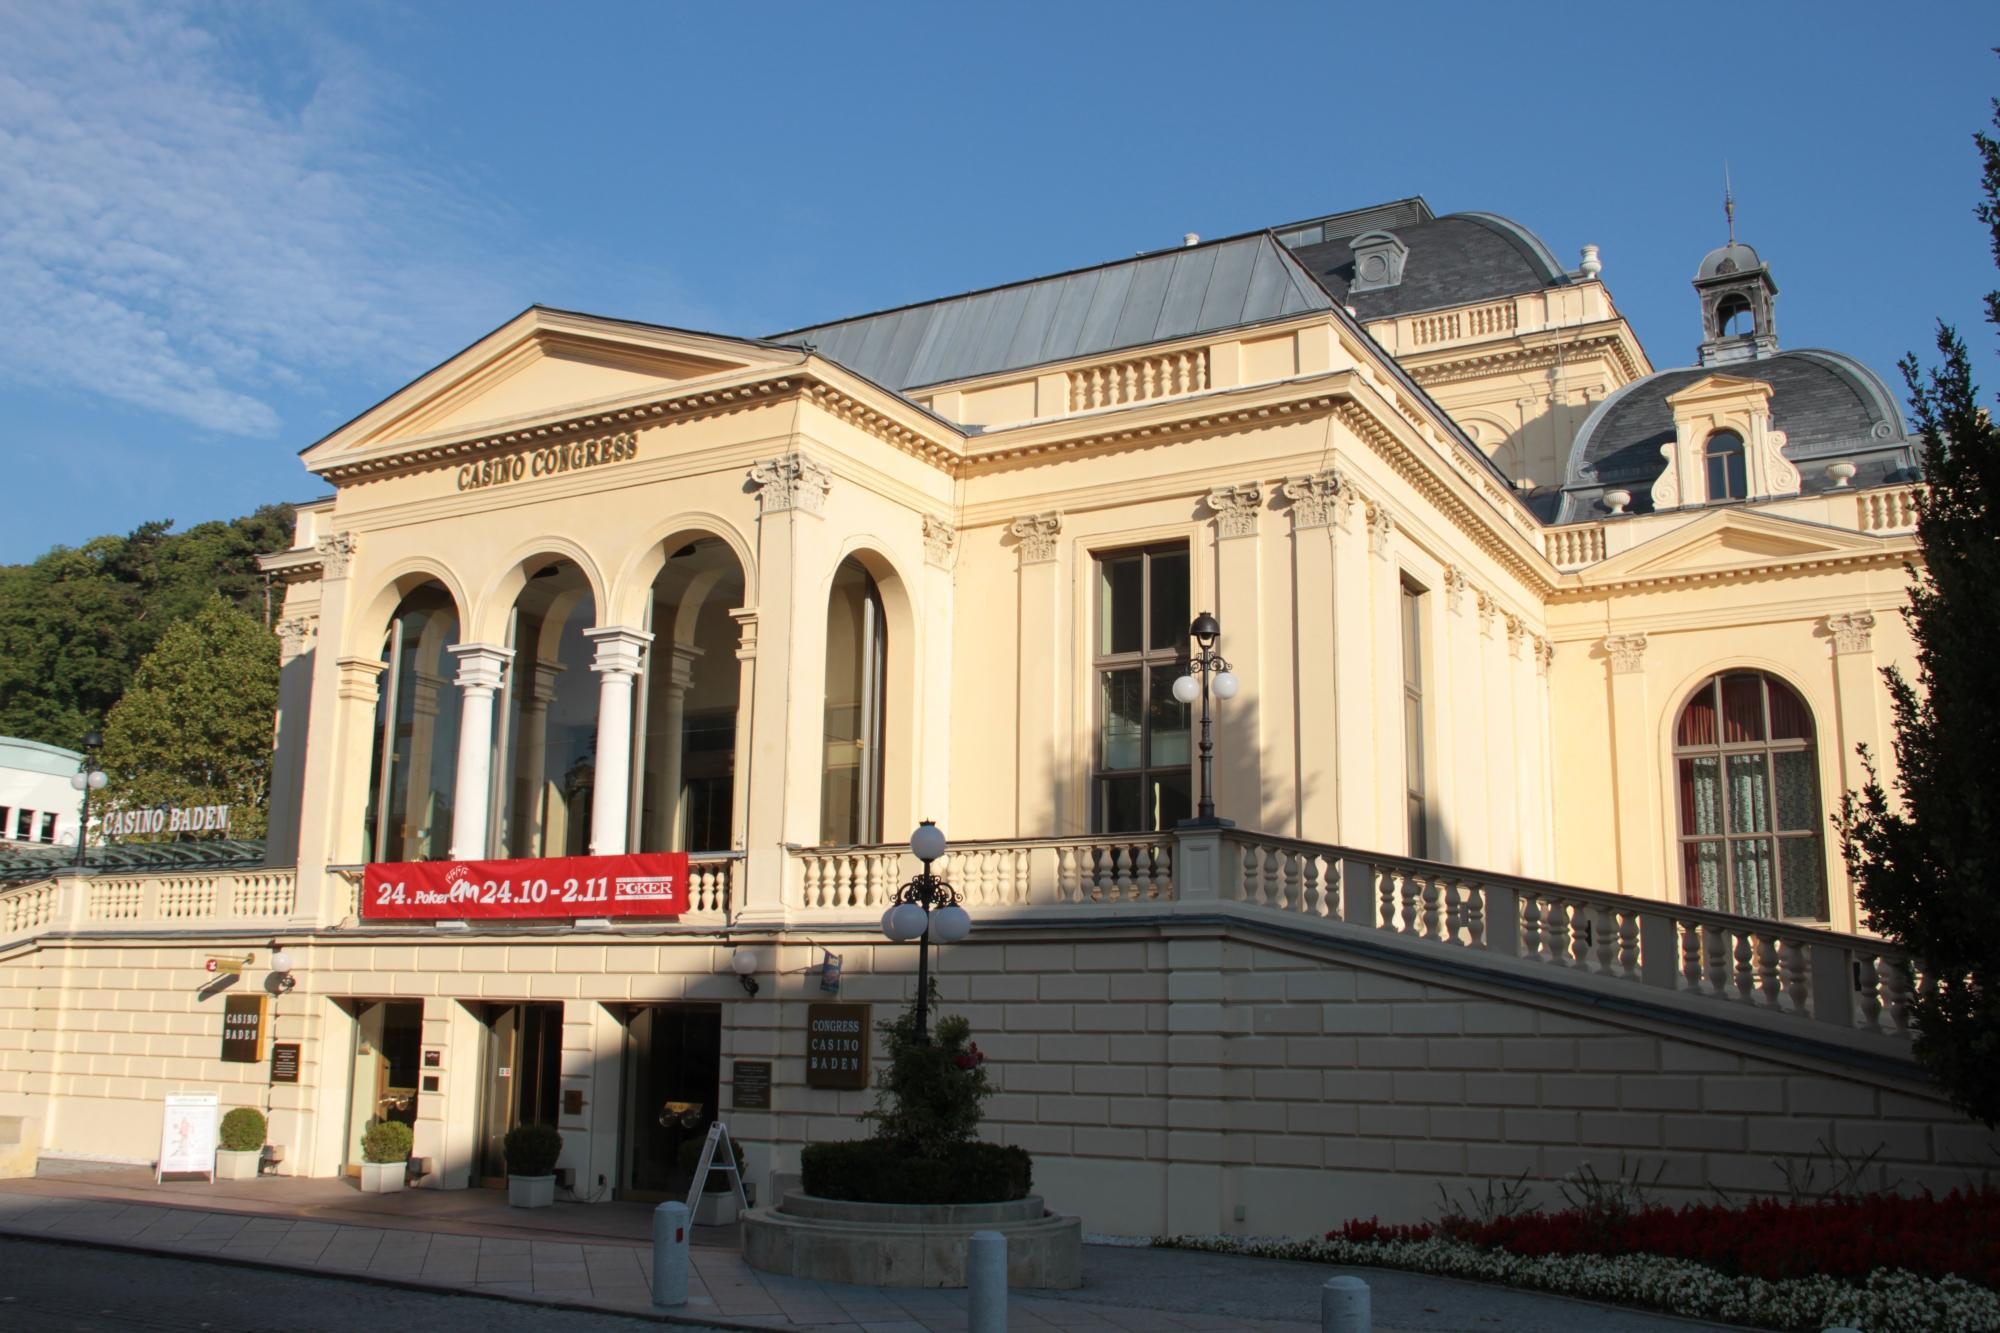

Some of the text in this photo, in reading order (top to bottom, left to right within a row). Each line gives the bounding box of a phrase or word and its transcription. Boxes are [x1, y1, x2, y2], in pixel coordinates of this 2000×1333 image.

[457, 432, 639, 491] CASINO CONGRESS
[103, 805, 229, 835] CASINO BADEN
[376, 881, 412, 905] 24.
[414, 889, 449, 905] Poker
[480, 878, 547, 904] 24.10
[561, 877, 608, 903] 2.11
[616, 882, 672, 895] POKER
[226, 1013, 258, 1025] CASINO
[812, 1020, 860, 1033] CONGRESS
[225, 1029, 257, 1040] BADEN
[811, 1038, 859, 1052] CASINO
[811, 1056, 858, 1071] BADEN
